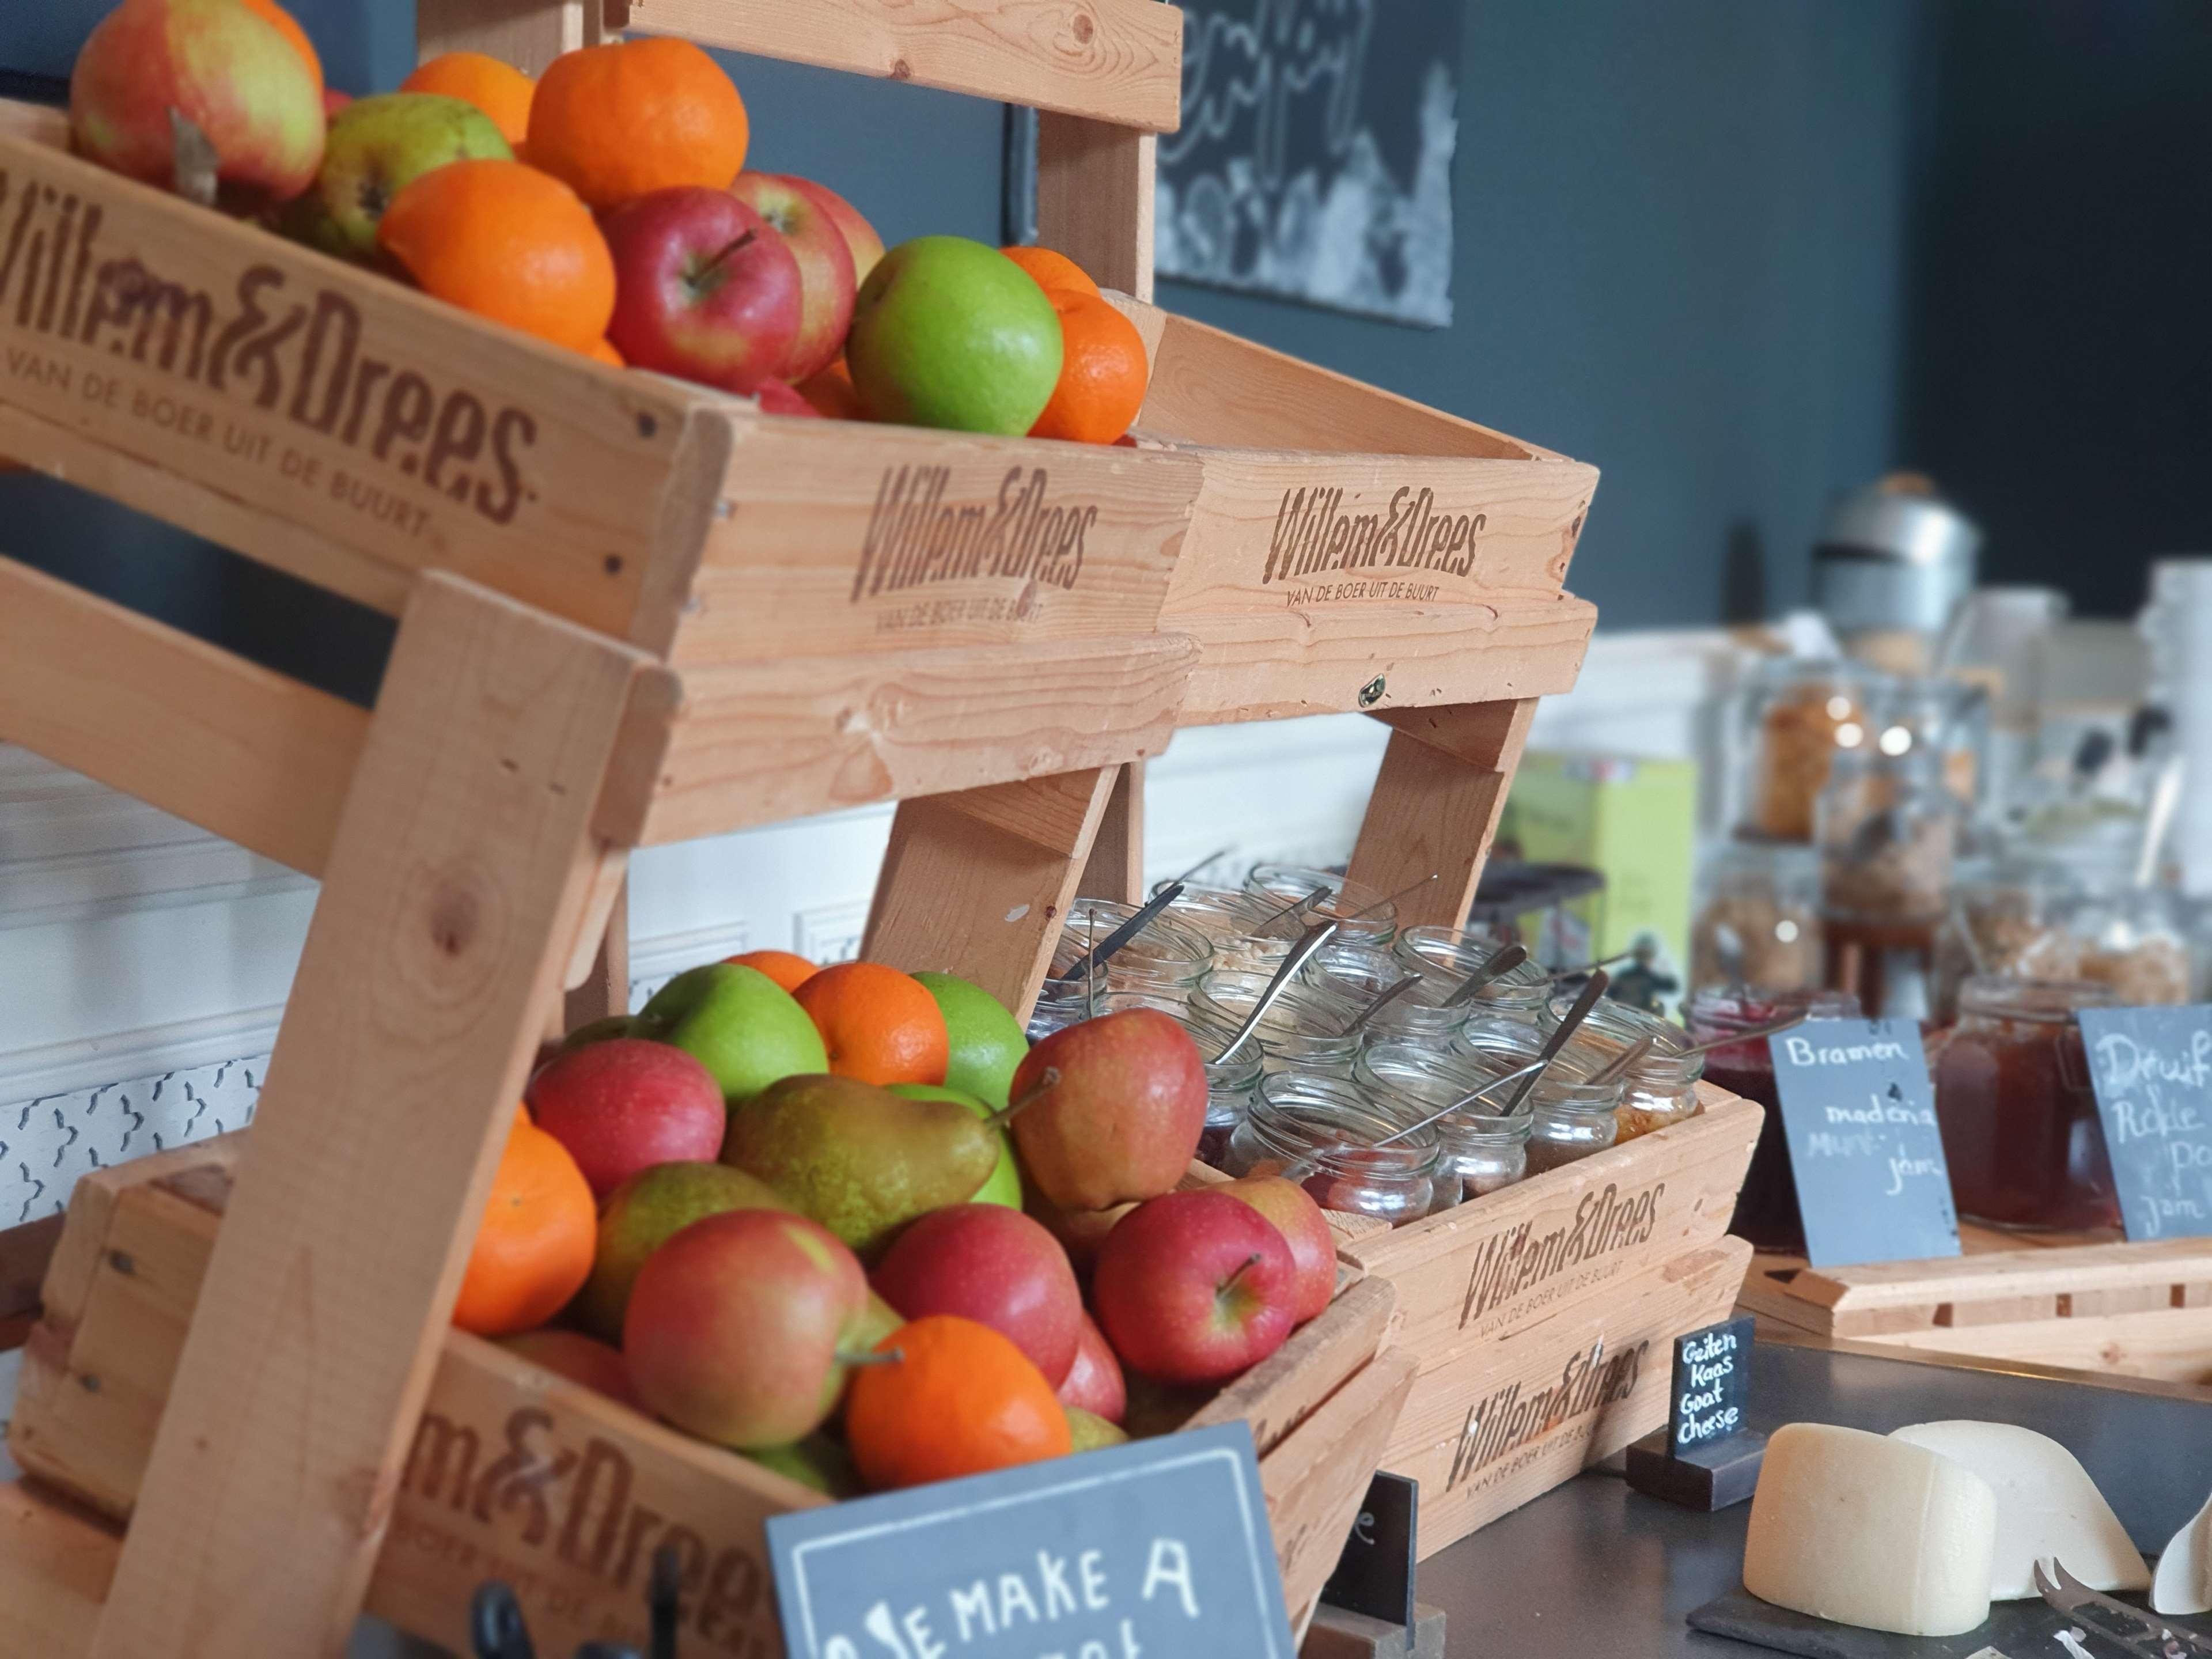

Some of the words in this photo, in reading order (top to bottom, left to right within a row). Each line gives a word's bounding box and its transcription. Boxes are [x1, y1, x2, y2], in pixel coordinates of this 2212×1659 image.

[7, 346, 72, 392] VAN
[82, 370, 121, 407] DE
[131, 388, 214, 441] BOER
[223, 423, 272, 464] UIT
[279, 447, 323, 489] DE
[328, 471, 432, 537] BUURT
[1262, 486, 1487, 584] Willem&Drees
[1287, 587, 1313, 607] VAN
[1316, 585, 1333, 603] DE
[1335, 582, 1367, 600] BOER
[1369, 582, 1388, 599] UIT
[1388, 582, 1405, 599] DE
[1405, 582, 1440, 601] BUURT
[1786, 1036, 1910, 1066] Bramen
[1458, 1183, 1665, 1331] Willem&Drees
[1682, 1332, 1737, 1364] Geiten
[1691, 1355, 1734, 1388] Kaas
[1680, 1378, 1724, 1415] Goat
[948, 1548, 1110, 1643] MAKE
[1141, 1536, 1201, 1620] A
